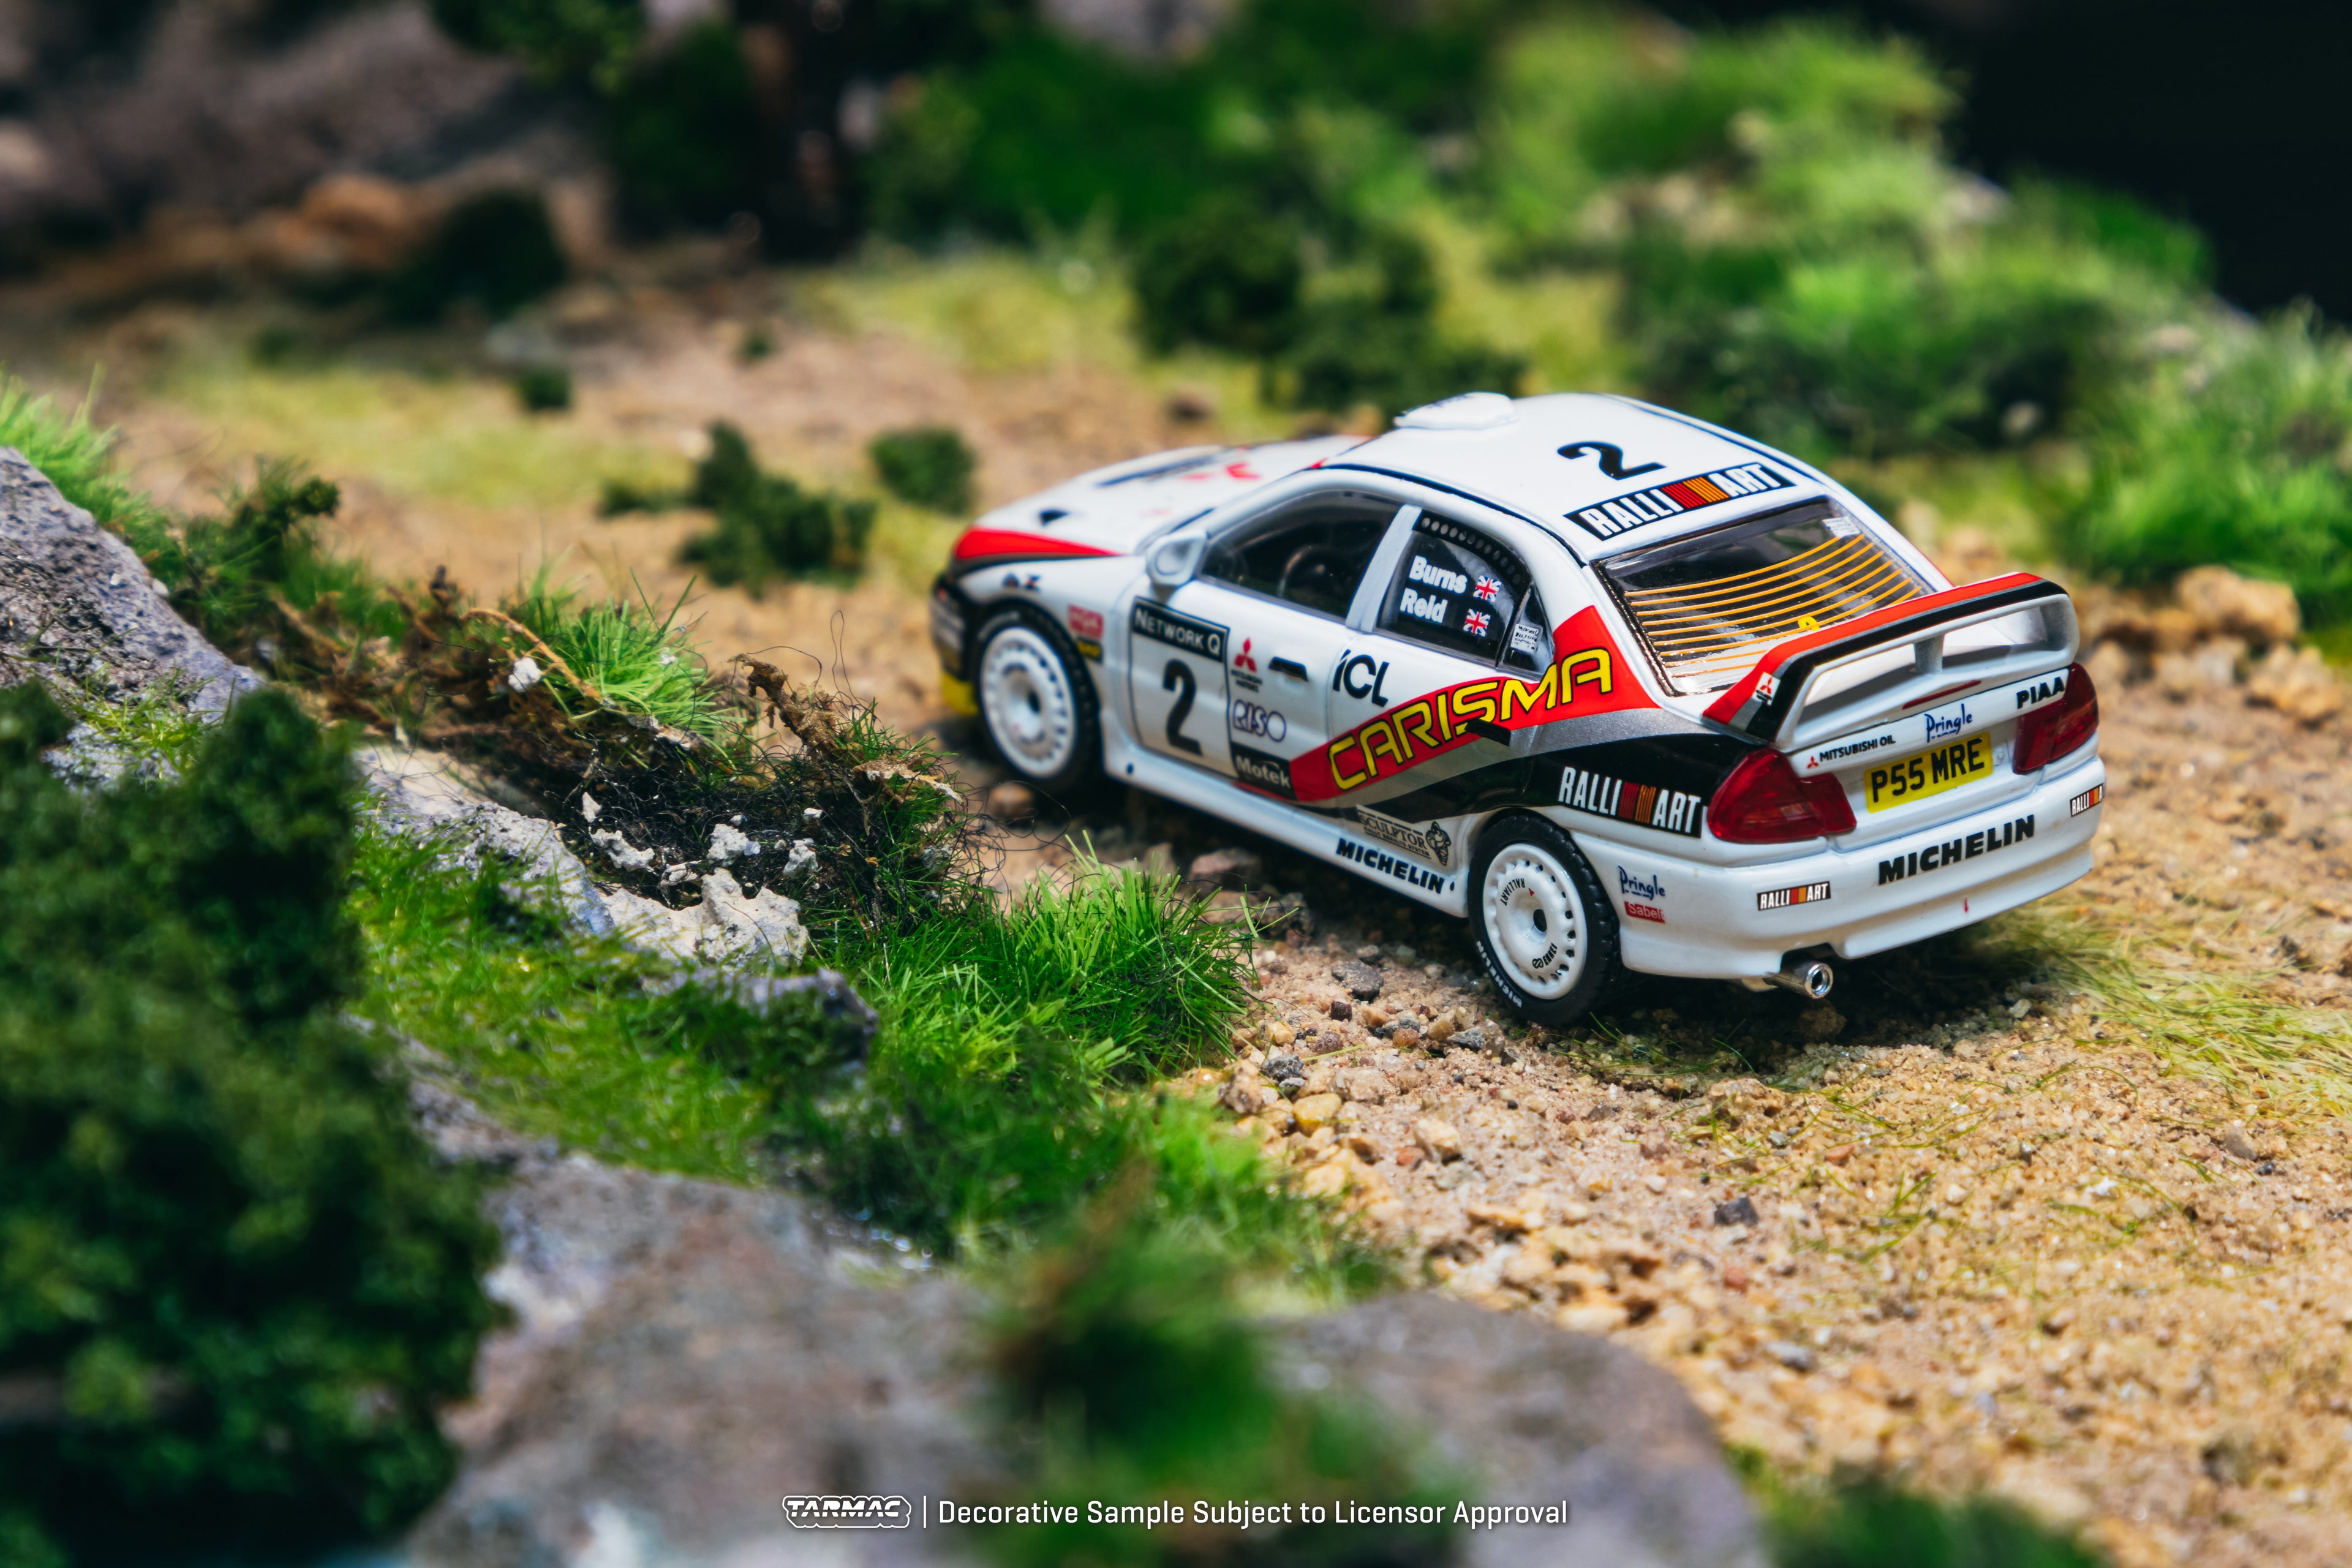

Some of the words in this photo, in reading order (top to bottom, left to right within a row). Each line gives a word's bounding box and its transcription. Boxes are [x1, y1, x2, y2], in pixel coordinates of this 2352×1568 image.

[1556, 441, 1667, 481] 2
[1409, 555, 1468, 594] Burns
[1400, 587, 1449, 624] Reid
[1207, 633, 1221, 656] Q
[1162, 658, 1203, 756] 2
[2016, 676, 2065, 710] PIAA
[1233, 699, 1286, 742] RISO
[1327, 647, 1612, 791] CARISMA
[1924, 703, 1973, 743] Pringle
[1819, 739, 1879, 762] MITSUBISHI
[1879, 734, 1896, 747] OIL
[1235, 755, 1291, 788] Motek
[1870, 756, 1926, 803] P55
[1931, 737, 1986, 785] MRE
[1359, 814, 1428, 850] SCULPTOR
[1878, 815, 2035, 885] MICHELIN
[1335, 837, 1445, 894] MICHELIN
[1618, 865, 1666, 901] Pringle
[1500, 878, 1526, 906] RALLIART
